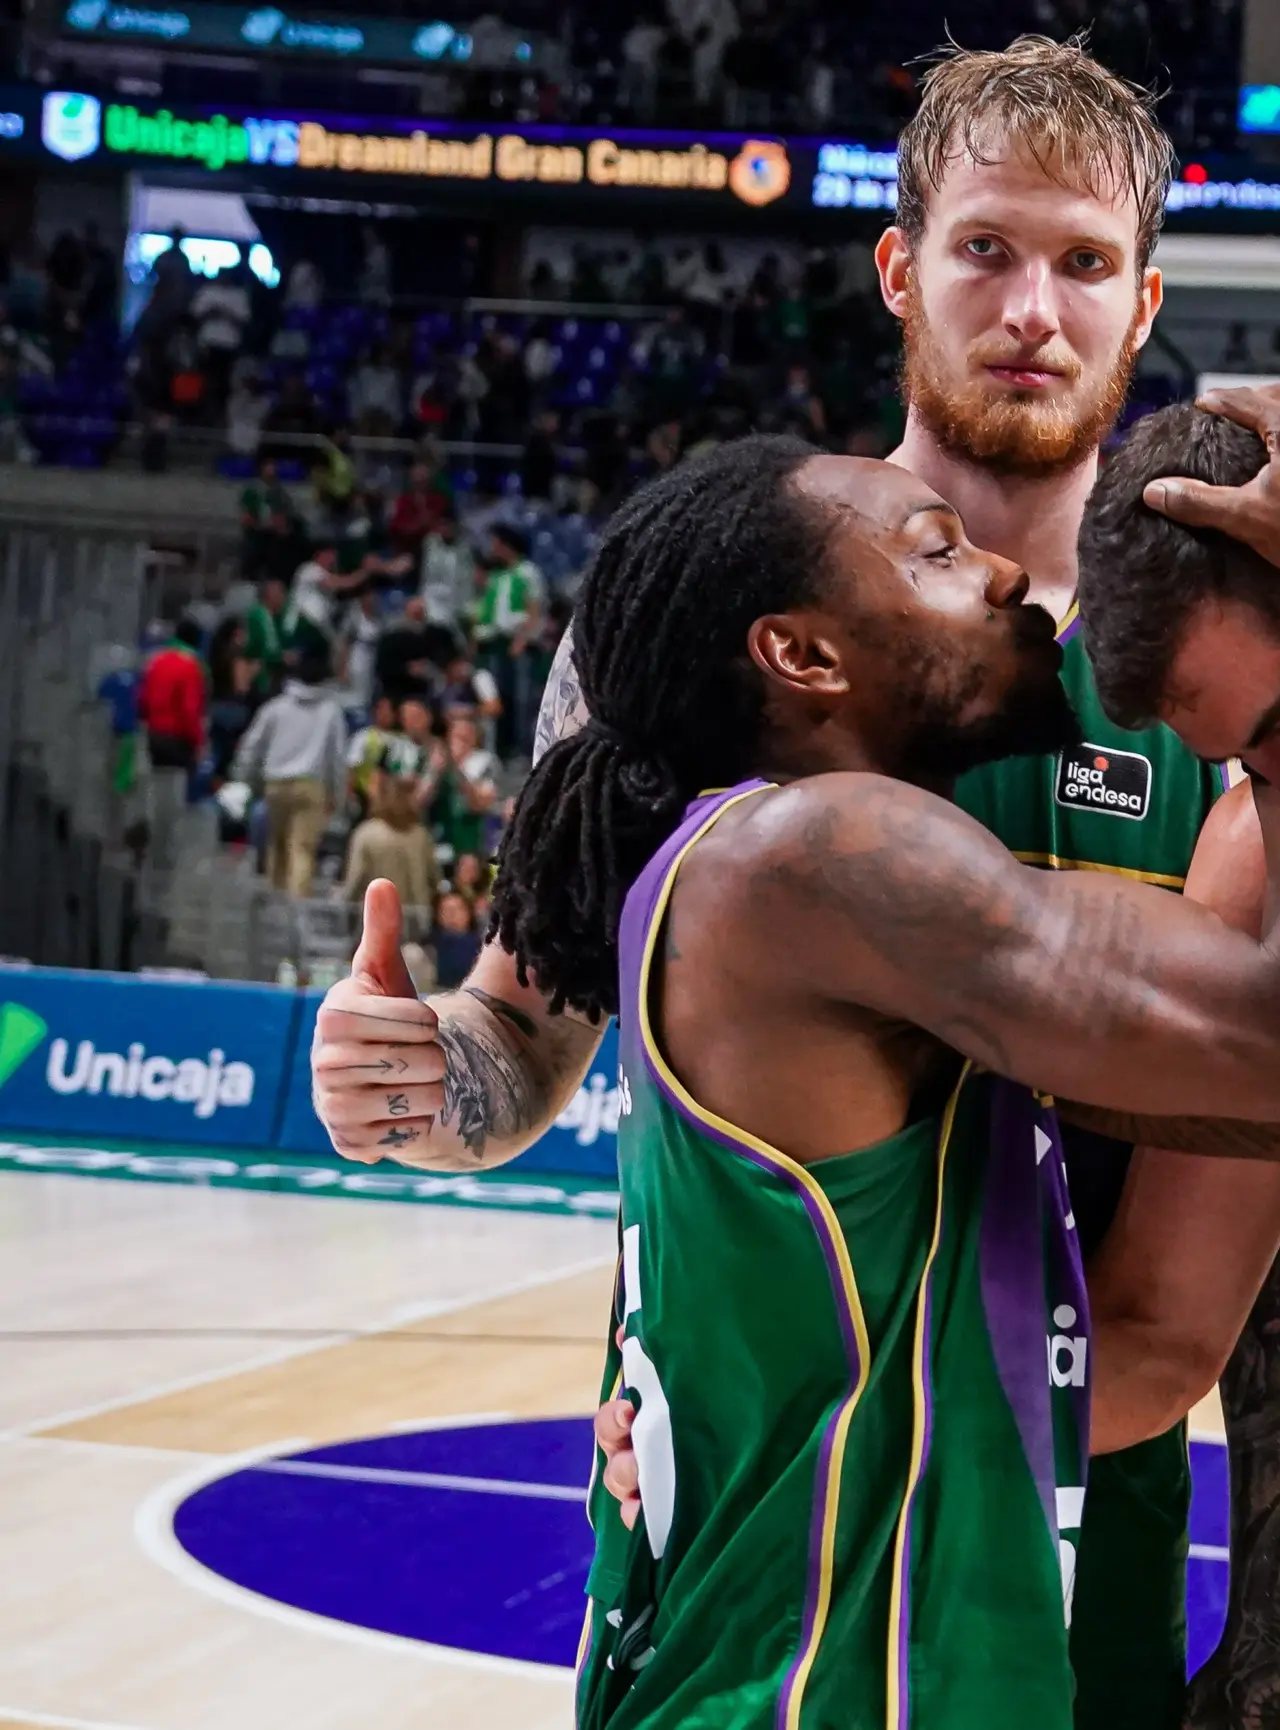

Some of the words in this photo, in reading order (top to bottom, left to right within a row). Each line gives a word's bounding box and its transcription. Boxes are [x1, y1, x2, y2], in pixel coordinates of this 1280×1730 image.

[105, 104, 248, 170] Unicaja
[244, 117, 299, 166] VS
[298, 122, 491, 180] Dreamland
[495, 134, 584, 184] Gran
[587, 139, 728, 190] Canaria
[1064, 782, 1142, 811] endesa
[1067, 761, 1104, 785] liga
[46, 1037, 255, 1119] Unicaja
